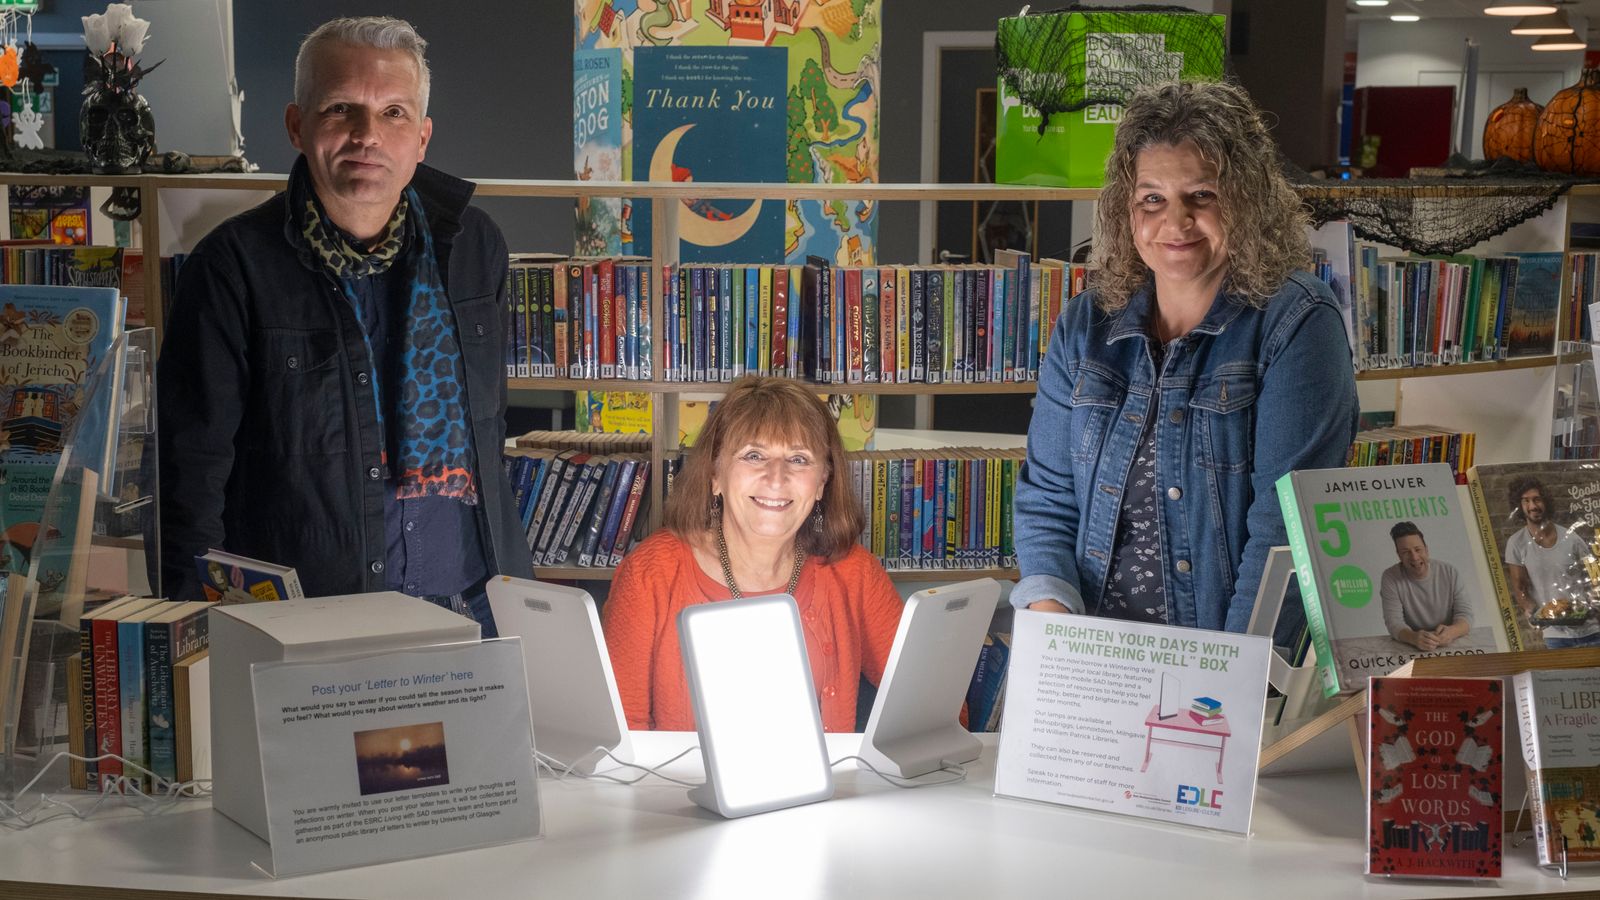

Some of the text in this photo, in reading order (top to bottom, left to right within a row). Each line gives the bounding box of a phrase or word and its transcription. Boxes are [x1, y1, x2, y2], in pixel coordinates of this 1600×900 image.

[1088, 36, 1162, 51] BORROW
[584, 57, 610, 70] ROSEN
[1088, 54, 1181, 68] DOWNLOAD
[1088, 72, 1120, 85] AND
[574, 80, 610, 119] STON
[646, 88, 775, 112] Thank You
[1087, 106, 1123, 120] EAU
[578, 108, 608, 149] DOG
[32, 328, 54, 341] The
[2, 344, 82, 361] Bookbinder
[8, 363, 70, 380] of Jericho
[518, 367, 528, 375] H
[695, 370, 702, 380] L
[914, 370, 922, 379] L
[1015, 370, 1024, 380] M
[12, 476, 50, 484] Around the
[1326, 478, 1426, 493] JAMIE OLIVER
[10, 485, 17, 493] in
[18, 484, 28, 493] 80
[9, 493, 30, 502] David
[1569, 502, 1583, 514] for
[1314, 496, 1448, 557] 5 INGREDIENTS
[1333, 577, 1368, 598] 1 MILLION
[1298, 564, 1327, 653] 5 INGREDIENTS
[187, 626, 195, 636] The
[1500, 606, 1520, 652] JOE WICKS
[1044, 623, 1239, 659] BRIGHTEN YOUR DAYS WITH
[1047, 638, 1229, 672] A “WINTERING WELL” BOX
[1349, 656, 1396, 669] QUICK
[1398, 656, 1406, 666] &
[1080, 659, 1103, 667] borrow
[1108, 663, 1140, 673] Wintering
[80, 628, 93, 731] THE WILD BOOK
[106, 648, 118, 712] LIBRARY
[150, 644, 160, 707] of Auschwitz
[159, 644, 168, 710] The Librarian
[311, 684, 336, 696] Post
[338, 680, 362, 696] your
[400, 676, 410, 688] to
[449, 671, 474, 681] here
[95, 644, 107, 729] UNWRITTEN
[300, 703, 320, 711] would
[398, 693, 416, 701] could
[484, 683, 505, 691] makes
[1540, 696, 1559, 705] THE
[282, 716, 295, 724] you
[296, 713, 312, 721] feel?
[331, 709, 351, 717] would
[351, 709, 364, 717] you
[421, 699, 446, 707] weather
[469, 694, 487, 703] light?
[1425, 712, 1449, 722] THE
[1518, 686, 1535, 768] LIBRARY
[1542, 713, 1597, 730] A Fragile
[1416, 730, 1456, 746] GOD
[1412, 774, 1460, 790] LOST
[1176, 784, 1223, 809] EDLC
[1401, 799, 1471, 816] WORDS
[1417, 859, 1474, 869] HACKWITH
